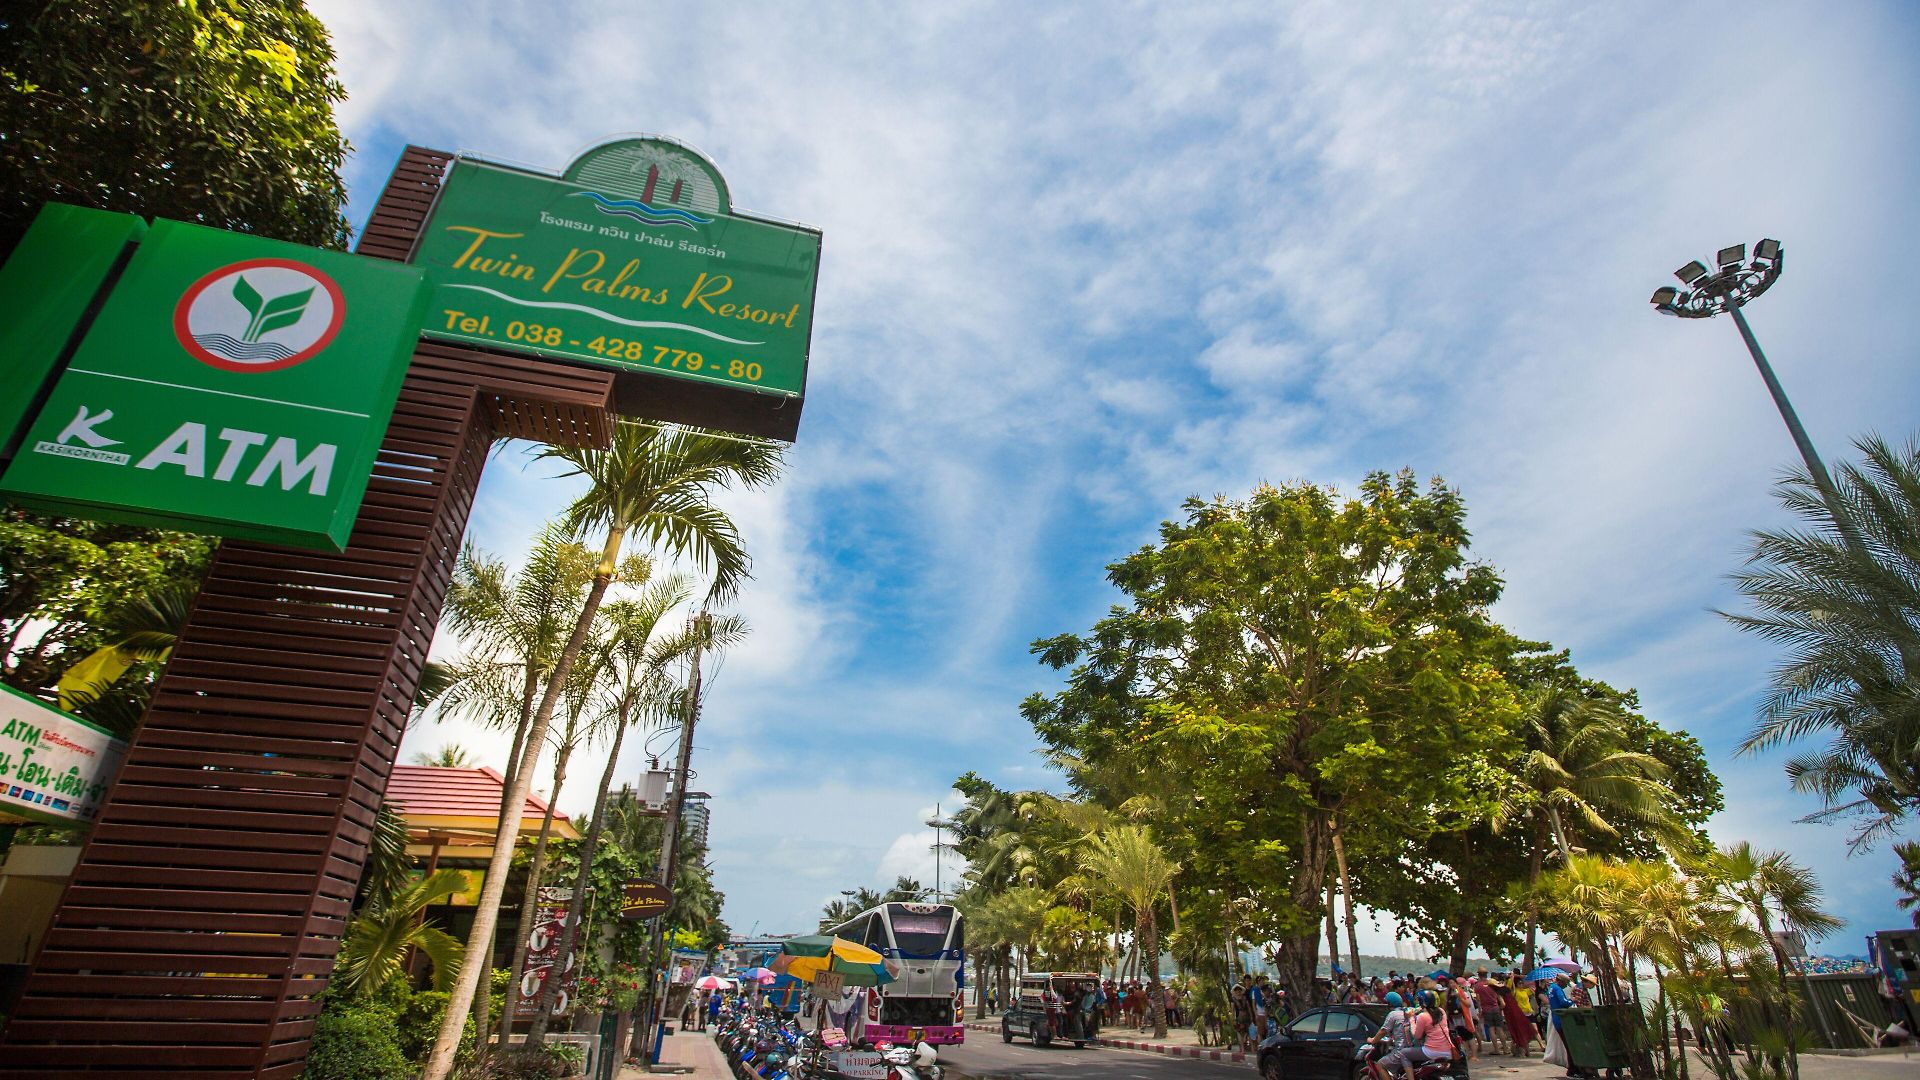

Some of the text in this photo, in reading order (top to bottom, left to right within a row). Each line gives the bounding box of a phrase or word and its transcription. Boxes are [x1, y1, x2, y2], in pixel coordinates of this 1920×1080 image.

[540, 211, 593, 232] โรงแรม
[599, 226, 629, 240] ทวิน
[635, 233, 674, 249] ปาล์ม
[446, 225, 800, 329] Twin Palms Resort
[444, 310, 494, 337] Tel.
[506, 320, 562, 347] 038
[588, 336, 643, 361] 428
[653, 345, 703, 371] 779
[728, 360, 763, 381] 80
[56, 405, 125, 448] K
[38, 443, 127, 464] KASIKORNTHAI
[134, 421, 338, 497] ATM
[0, 718, 41, 747] ATM
[817, 972, 840, 991] TAXI
